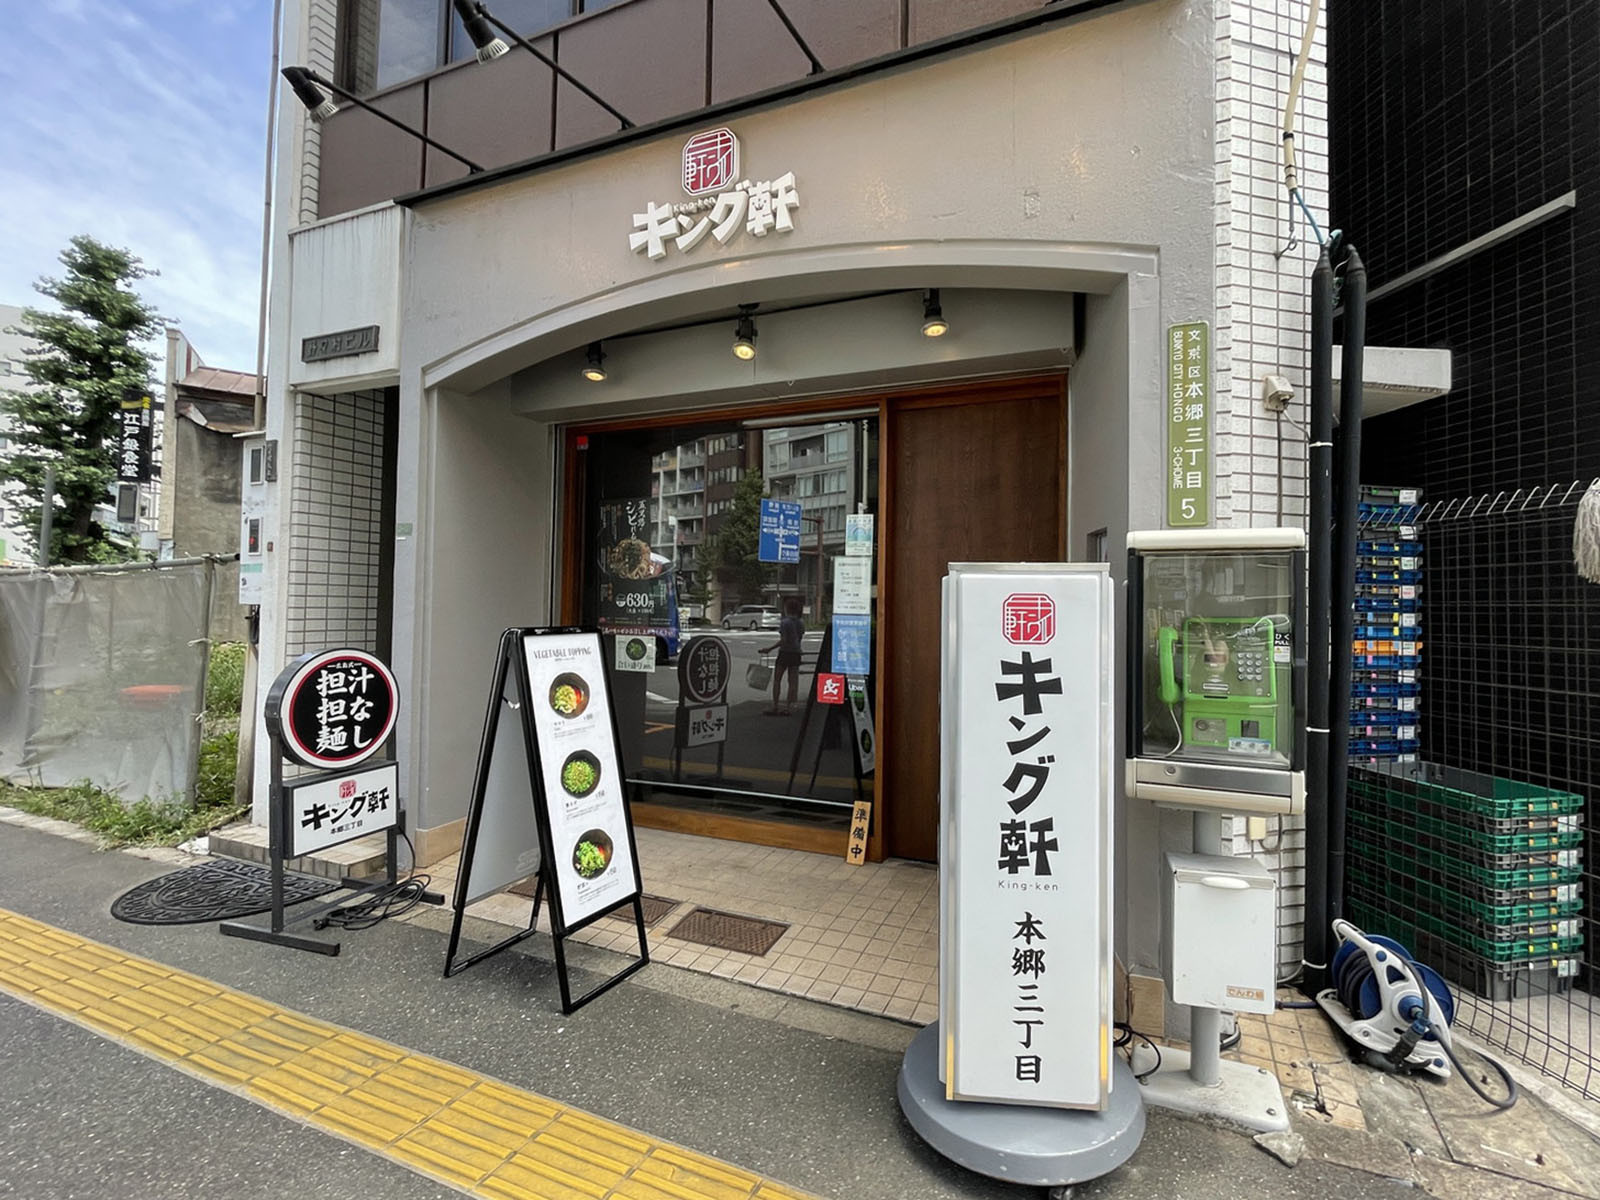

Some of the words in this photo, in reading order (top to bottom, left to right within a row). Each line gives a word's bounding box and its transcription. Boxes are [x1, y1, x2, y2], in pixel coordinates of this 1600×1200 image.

[629, 171, 800, 261] キング軒
[1172, 331, 1184, 361] BUNKYO
[1172, 383, 1184, 423] HONGO
[1184, 329, 1204, 489] 文京区本郷三丁目
[1172, 446, 1184, 489] 3-CHOME
[1181, 497, 1196, 519] 5
[315, 669, 349, 755] 担担麺
[348, 666, 375, 749] 汁なし
[995, 651, 1063, 876] キング軒
[301, 786, 390, 831] キング軒
[850, 808, 868, 859] 準備中
[998, 880, 1059, 891] King-ken
[1011, 911, 1047, 1083] 本郷三丁目
